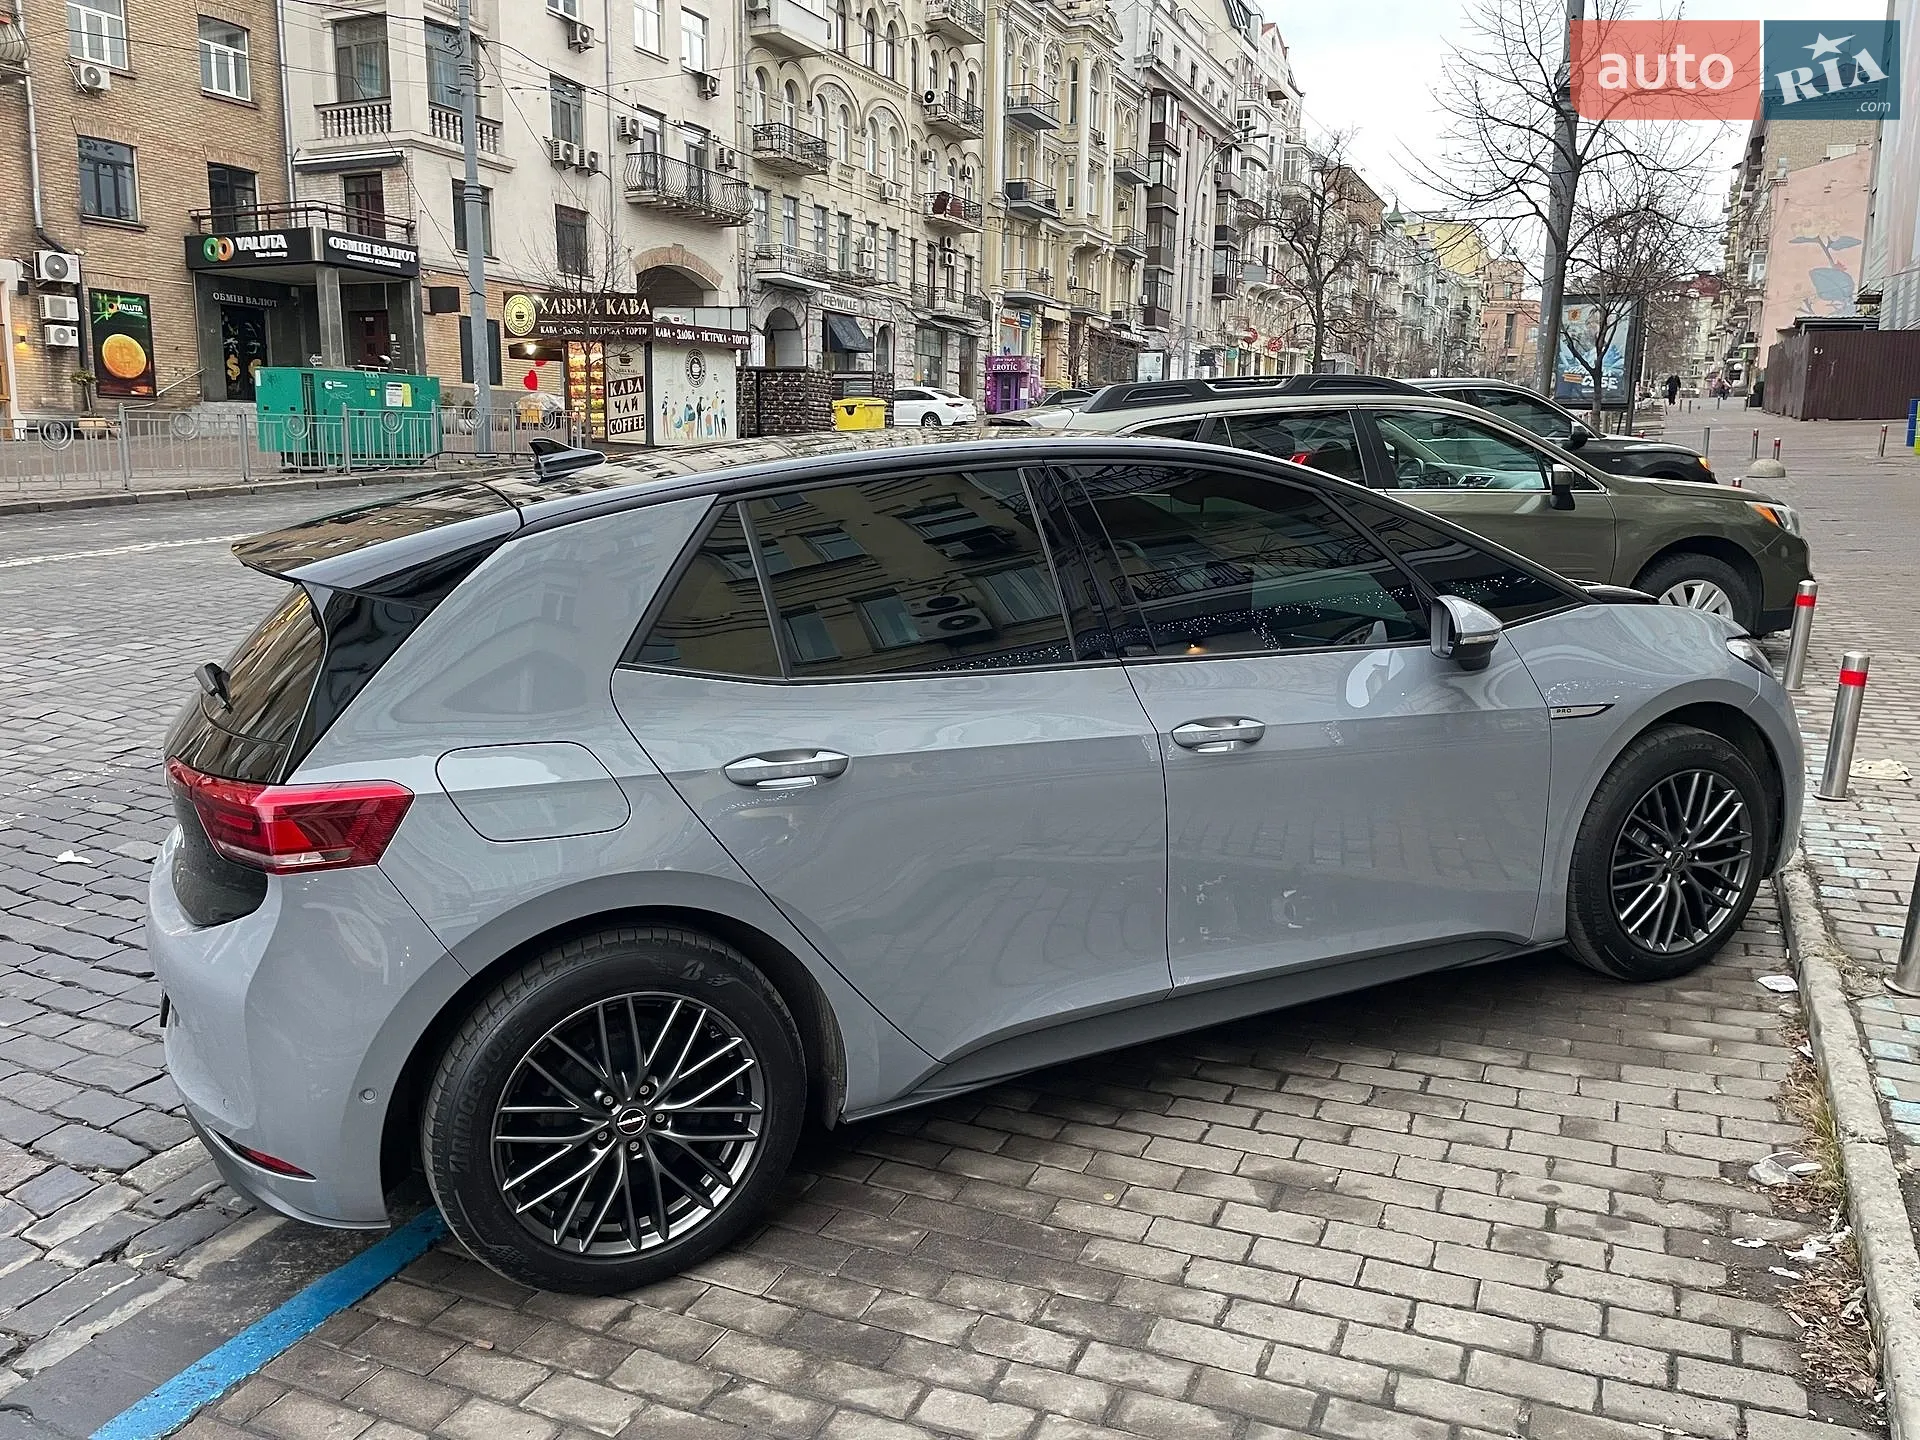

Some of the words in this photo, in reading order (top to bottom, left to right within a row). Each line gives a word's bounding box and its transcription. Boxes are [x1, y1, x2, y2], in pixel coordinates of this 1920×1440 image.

[235, 234, 288, 250] VALUTA
[328, 236, 372, 255] ОБМІН
[372, 244, 416, 262] ВАЛЮТ
[213, 292, 244, 304] ОБМІН
[245, 296, 277, 308] ВАЛЮТ
[606, 298, 650, 315] КАВА
[540, 325, 558, 335] КАВА
[625, 326, 647, 336] ТОРТИ
[655, 327, 671, 338] КАВА
[609, 378, 643, 396] КАВА
[614, 395, 638, 413] ЧАЙ
[610, 415, 644, 434] COFFEE
